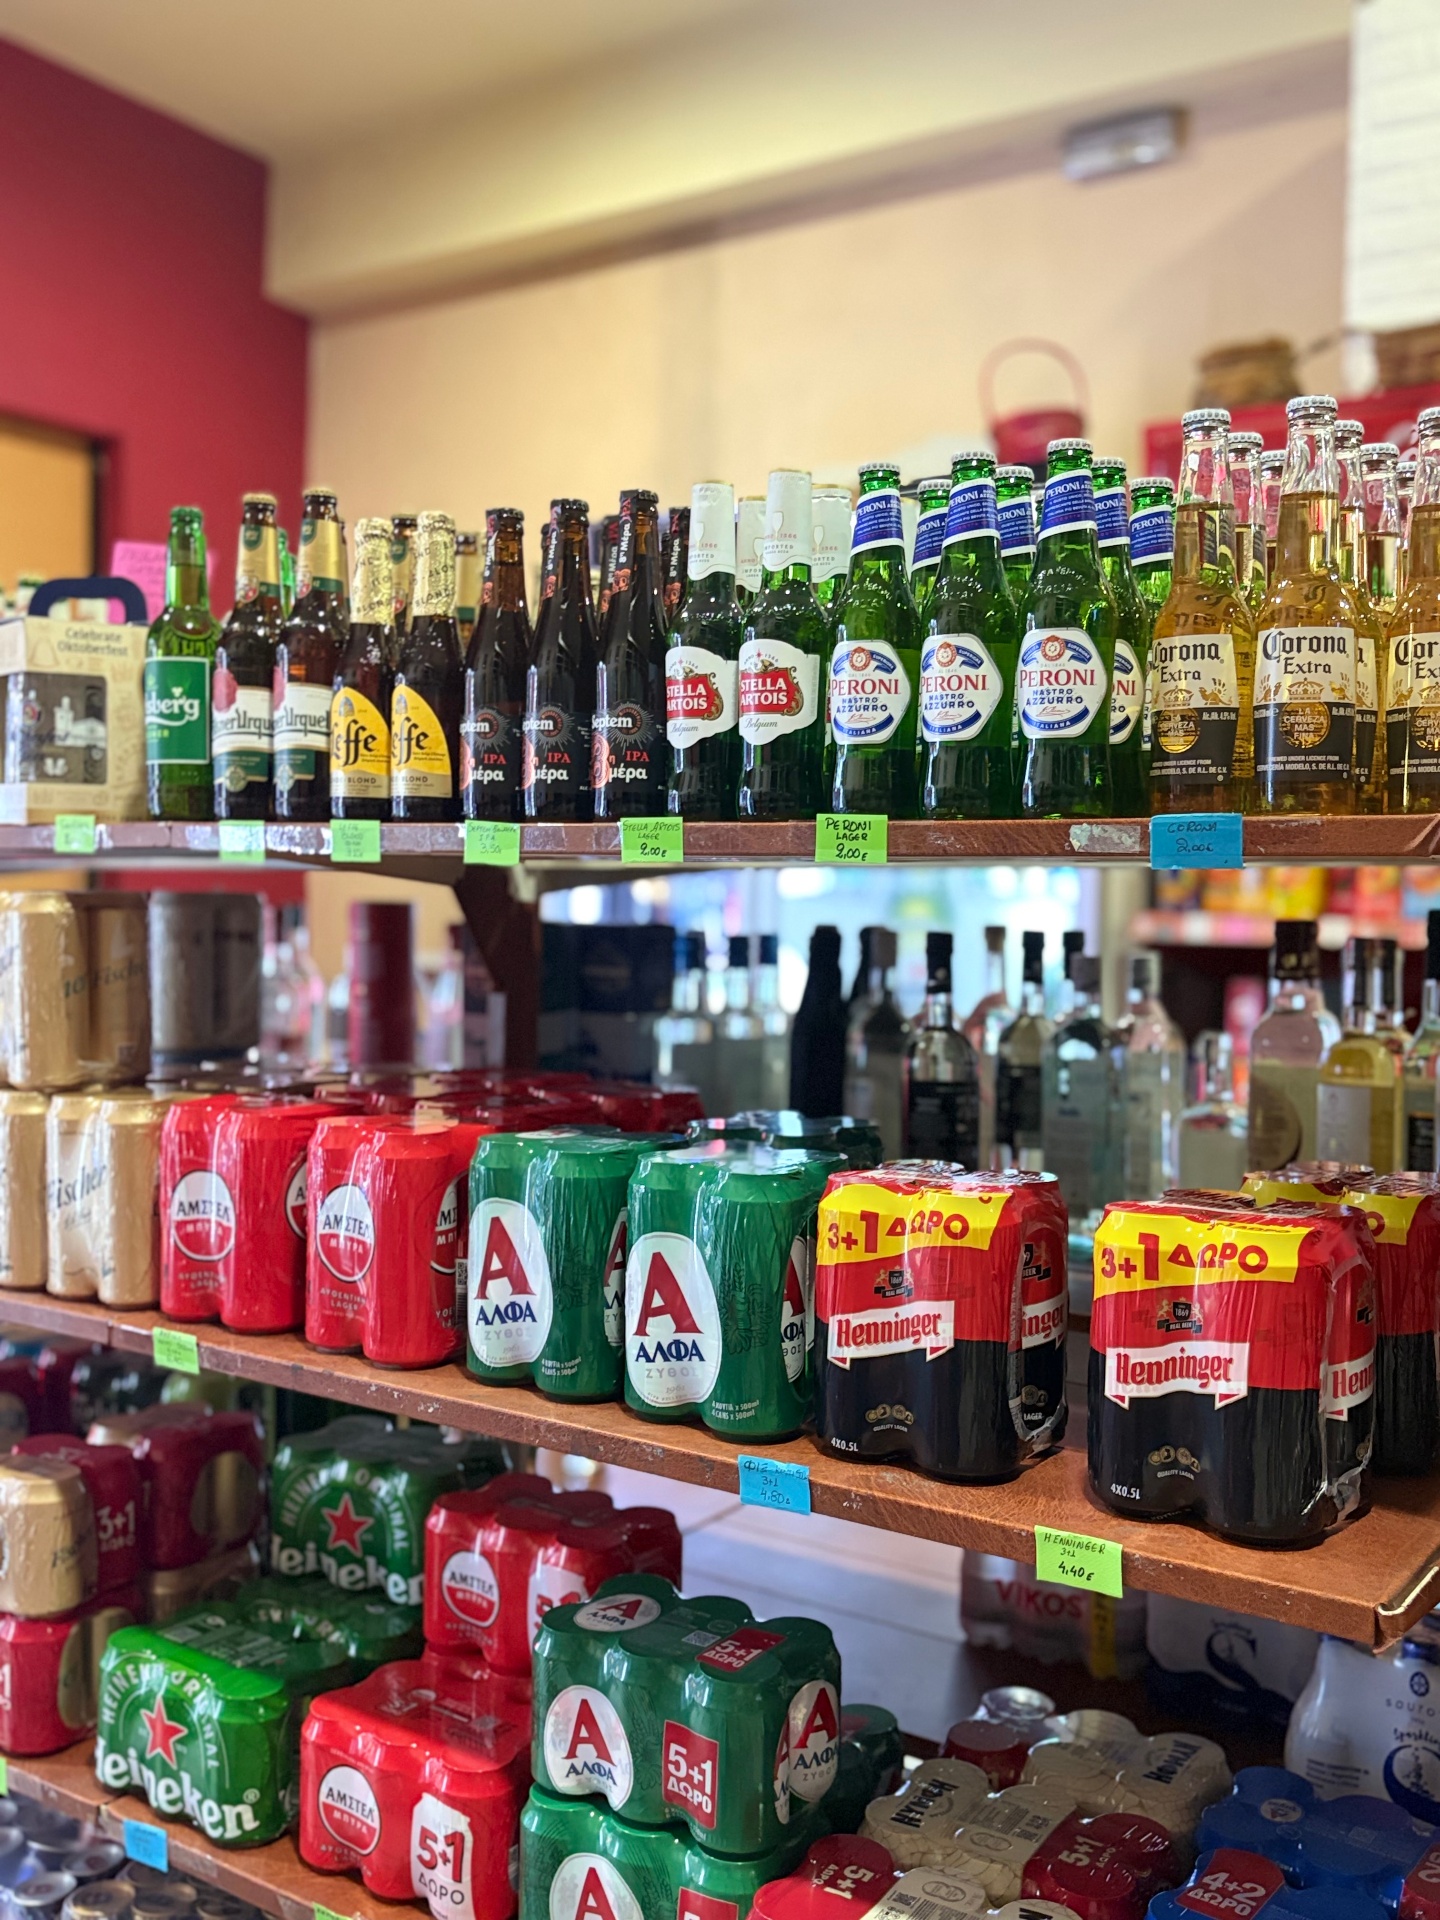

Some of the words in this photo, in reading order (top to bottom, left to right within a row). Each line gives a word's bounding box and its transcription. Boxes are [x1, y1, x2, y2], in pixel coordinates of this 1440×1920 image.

[1045, 481, 1081, 500] PERONI
[1131, 515, 1165, 533] PERONI
[1153, 640, 1222, 671] Corona
[1262, 631, 1347, 664] Corona
[1160, 666, 1202, 684] Extra
[1283, 657, 1332, 676] Extra
[740, 677, 788, 692] STELLA
[831, 678, 900, 697] PERONI
[921, 674, 988, 694] PERONI
[1020, 668, 1096, 689] PERONI
[666, 683, 707, 697] STELLA
[740, 692, 788, 706] ARTOIS
[929, 693, 965, 701] NASTRO
[1032, 688, 1073, 697] NASTRO
[666, 697, 708, 711] ARTOIS
[836, 704, 888, 714] AZZURRO
[842, 696, 879, 704] NASTRO
[924, 700, 975, 711] AZZURRO
[1026, 696, 1083, 706] AZZURRO
[669, 722, 700, 736] Belgium
[745, 718, 778, 732] Belgium
[929, 724, 963, 733] ITALIANA
[1032, 720, 1071, 730] ITALIANA
[1283, 715, 1325, 724] CERVEZA
[1294, 723, 1315, 731] MAS
[843, 727, 877, 736] ITALIANA
[484, 753, 507, 765] IPA
[547, 752, 571, 764] IPA
[625, 751, 650, 762] IPA
[470, 766, 505, 785] μέρα
[532, 765, 569, 784] μέρα
[608, 763, 648, 783] μέρα
[623, 819, 648, 832] STELLA
[650, 821, 681, 833] ARTOIS
[825, 817, 872, 831] PERONI
[1167, 821, 1217, 833] CORONA
[637, 832, 660, 841] LAGER
[836, 832, 868, 842] LAGER
[826, 1209, 880, 1254] 3+1
[885, 1209, 970, 1241] ΔΩΡΟ
[1100, 1232, 1160, 1282] 3+1
[1166, 1242, 1269, 1275] ΔΩΡΟ
[475, 1300, 538, 1326] ΑΛΦΑ
[1175, 1308, 1190, 1317] 1869
[836, 1311, 943, 1348] Henninger
[634, 1338, 706, 1363] ΑΛΦΑ
[1115, 1347, 1233, 1388] Henninger
[1023, 1413, 1043, 1421] LAGER
[830, 1436, 859, 1452] 4X0.5L
[761, 1475, 779, 1487] 3+1
[1156, 1470, 1178, 1479] QUALITY
[1110, 1482, 1141, 1501] 4X0.5L
[1043, 1532, 1106, 1555] HENNINGER
[996, 1580, 1084, 1619] VIKOS
[703, 1649, 746, 1669] ΔΩΡΟ
[714, 1639, 763, 1663] 5+1
[565, 1761, 618, 1787] ΑΛΦΑ
[667, 1742, 713, 1797] 5+1
[326, 1786, 376, 1823] ΑΜΣΤΕΛ
[666, 1778, 713, 1815] ΔΩΡΟ
[333, 1809, 368, 1834] ΜΠΥΡΑ
[416, 1825, 466, 1884] 5+1
[1060, 1834, 1104, 1868] 5+1
[1096, 1846, 1117, 1868] ΔΩΡΟ
[418, 1872, 465, 1905] ΔΩΡΟ
[824, 1864, 875, 1900] 5+1
[1202, 1871, 1266, 1907] 4+2
[1186, 1888, 1252, 1917] ΔΩΡΟ
